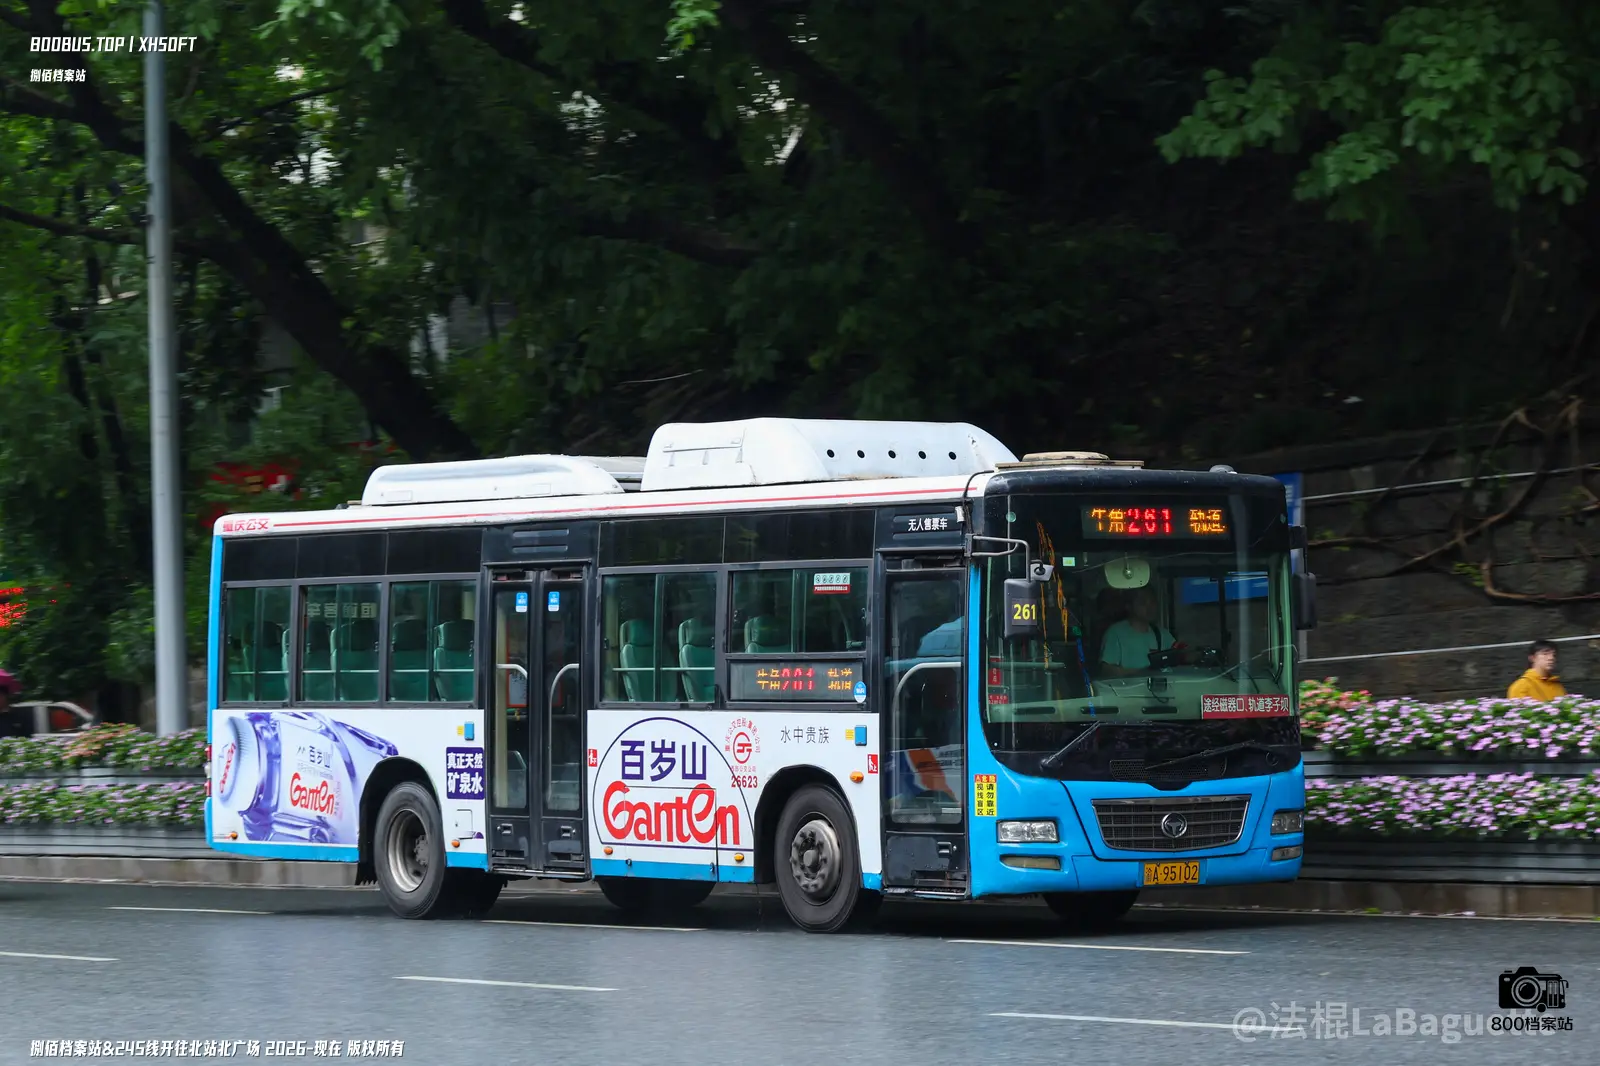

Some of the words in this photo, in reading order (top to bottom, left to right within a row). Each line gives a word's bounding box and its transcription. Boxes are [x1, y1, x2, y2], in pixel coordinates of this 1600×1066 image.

[222, 518, 270, 532] 重庆公交
[908, 517, 948, 532] 无人售票车
[1013, 603, 1036, 620] 261
[1203, 697, 1289, 712] 途经磁器口、轨道李子坝
[780, 725, 830, 744] 水中贵族
[447, 752, 484, 769] 真正天然
[620, 738, 707, 782] 百岁山
[447, 772, 484, 795] 矿泉水
[731, 775, 758, 789] 26623
[290, 772, 335, 815] Ganten
[602, 780, 741, 846] Ganten
